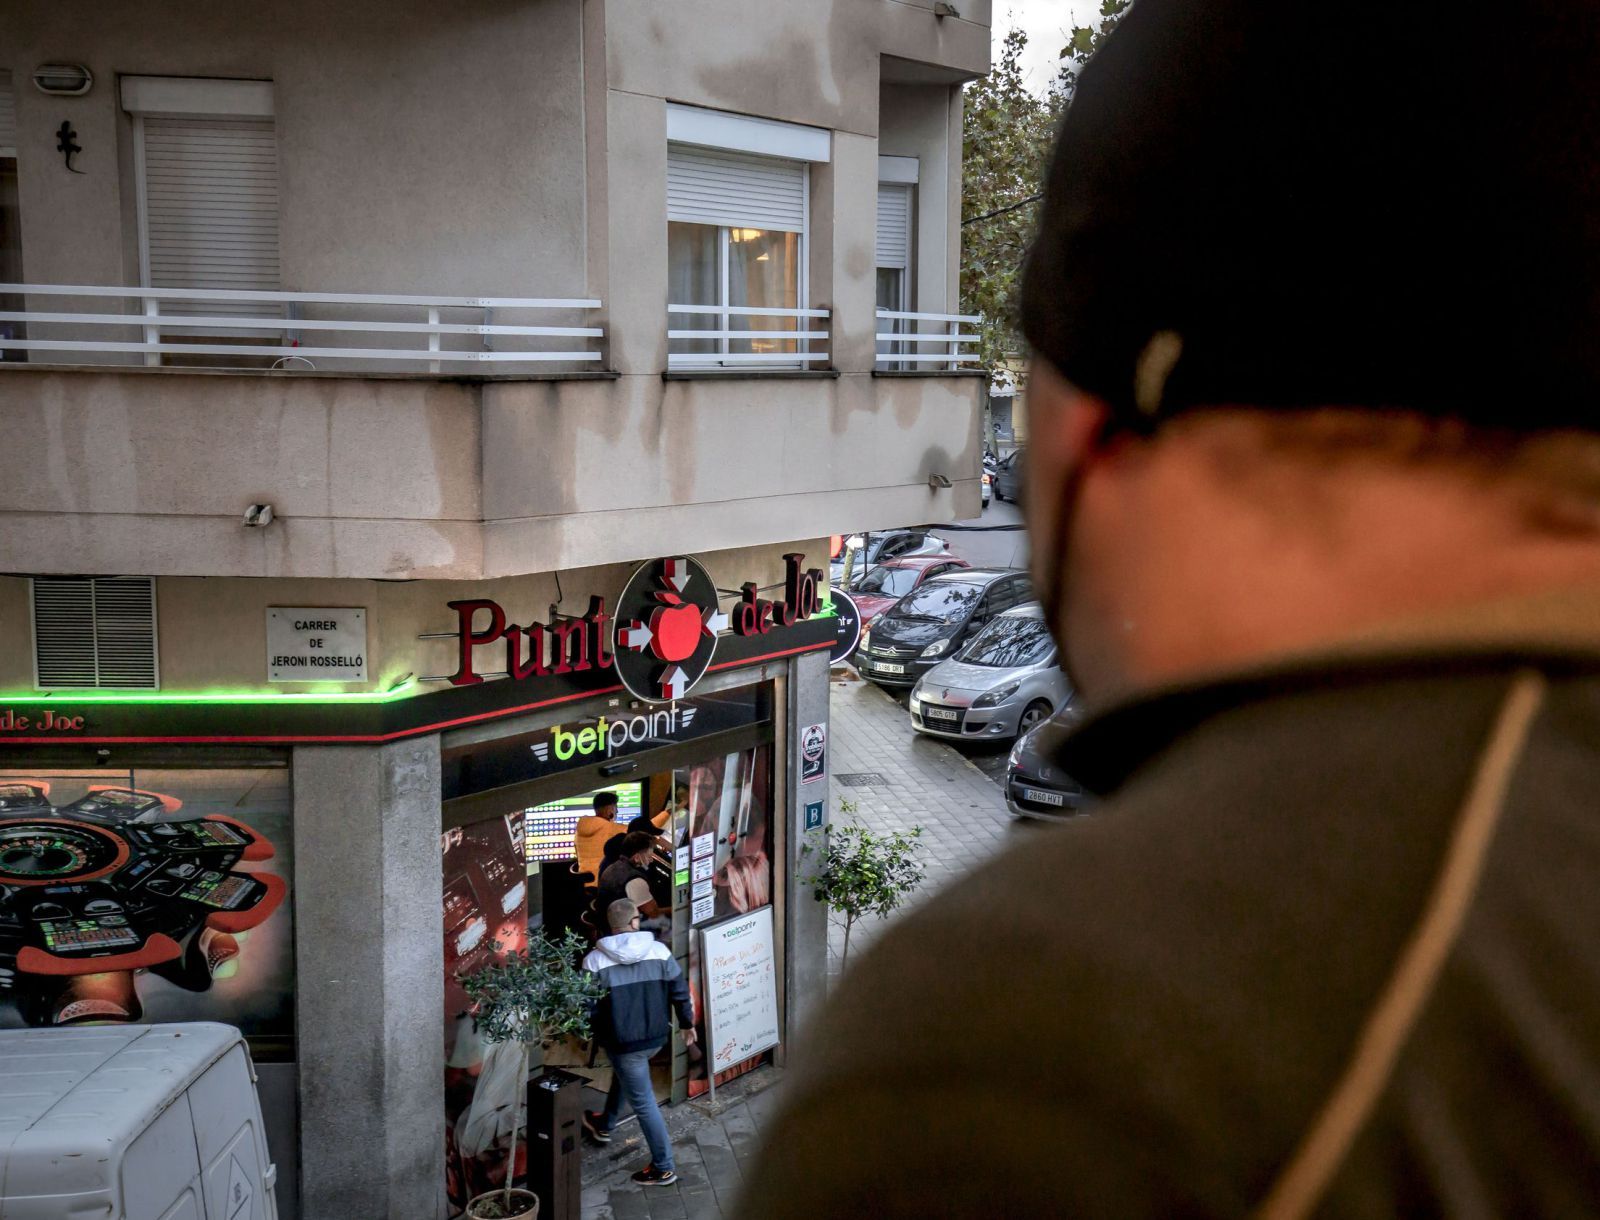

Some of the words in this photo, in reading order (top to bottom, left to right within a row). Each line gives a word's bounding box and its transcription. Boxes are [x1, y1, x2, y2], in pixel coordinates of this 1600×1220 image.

[294, 620, 337, 631] CARRER
[447, 595, 614, 685] Punt
[732, 582, 773, 636] de
[772, 553, 824, 628] Joc
[309, 638, 323, 648] DE
[271, 655, 307, 667] JERONI
[310, 653, 363, 667] ROSSELLÓ
[0, 709, 29, 731] de
[36, 710, 85, 731] Joc
[550, 701, 680, 760] betpoint
[1029, 791, 1047, 802] 2860
[1047, 793, 1062, 804] HVT
